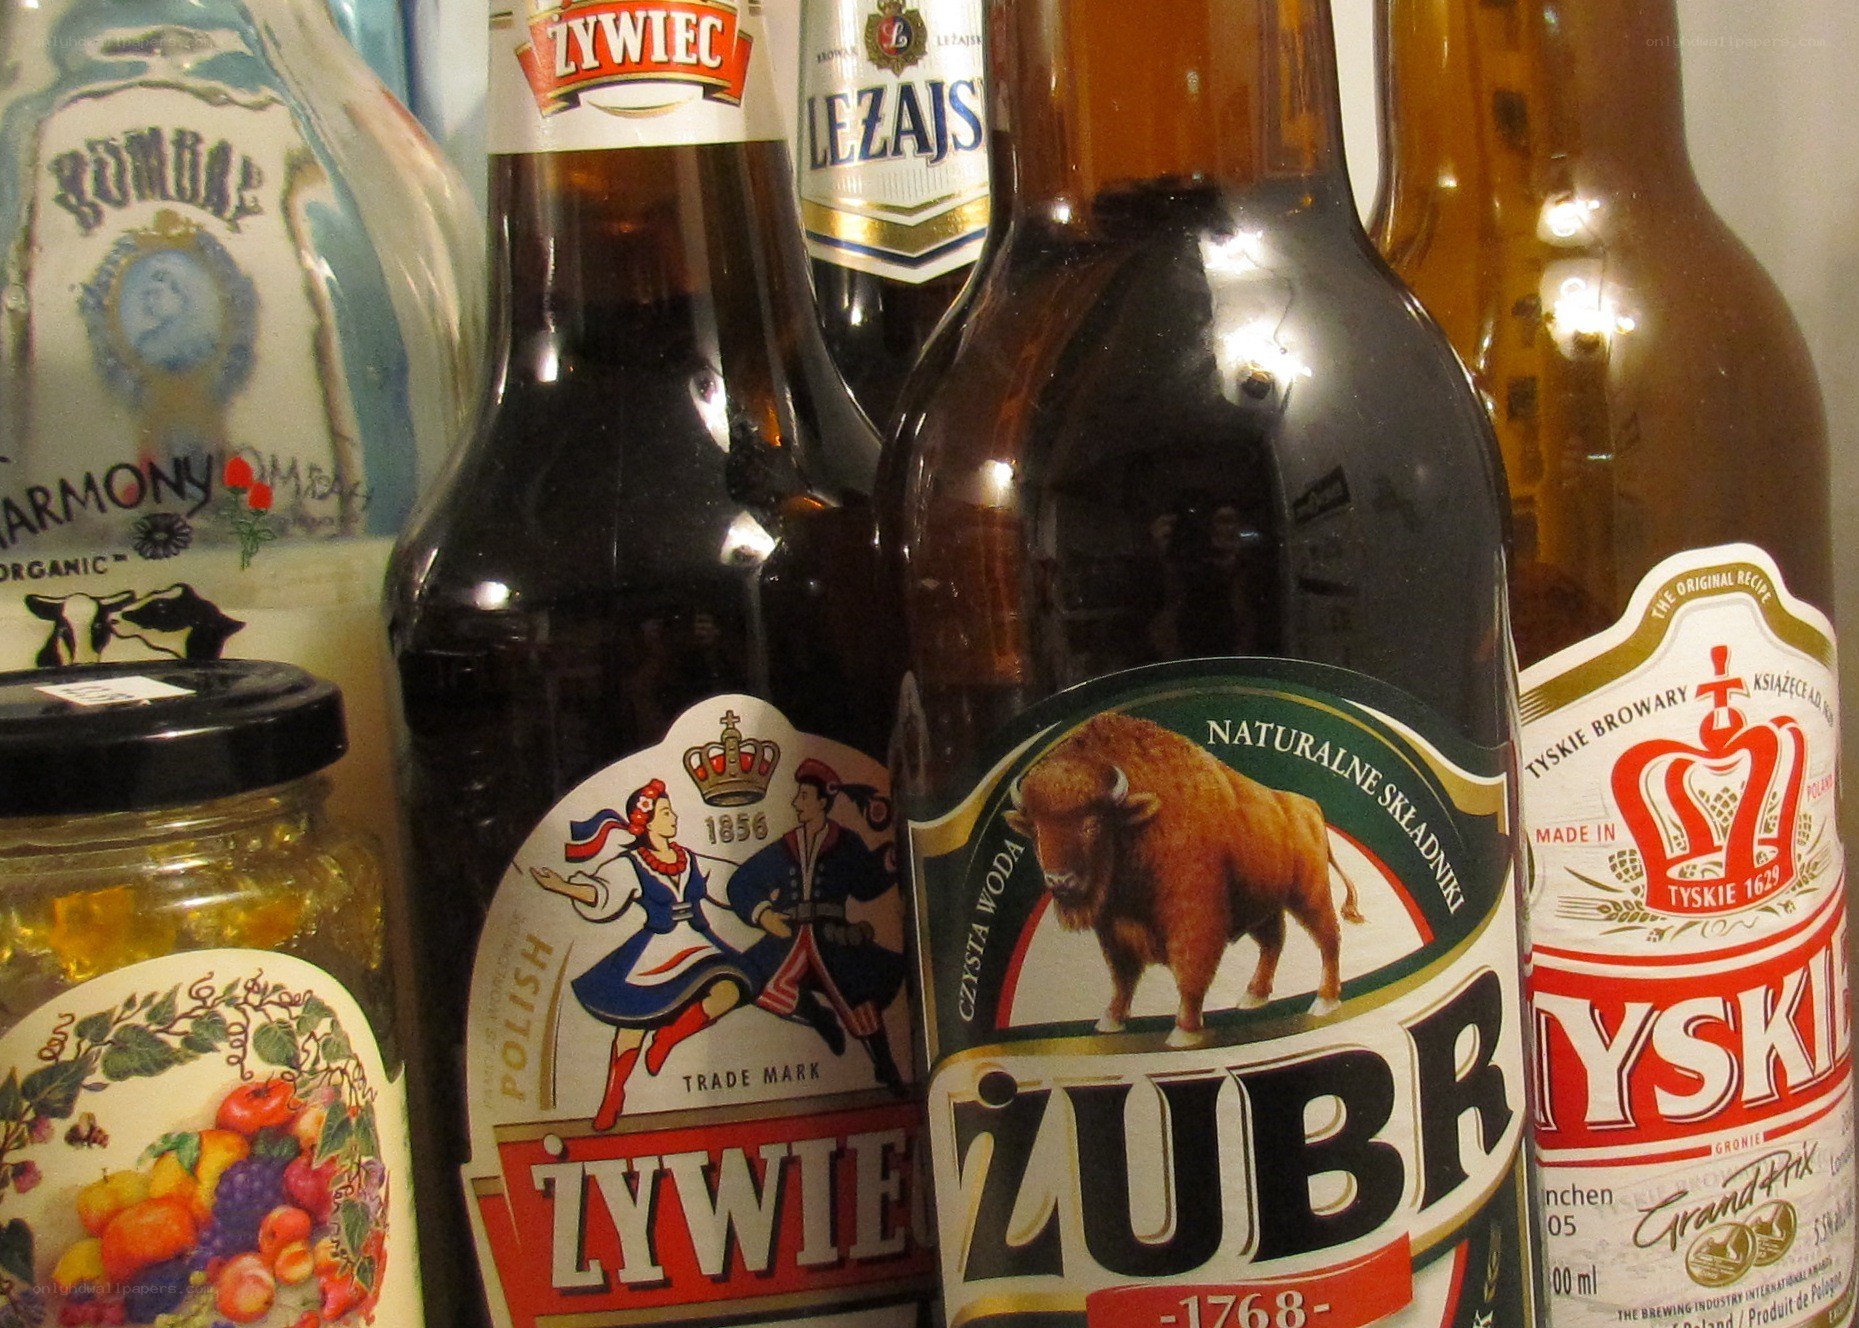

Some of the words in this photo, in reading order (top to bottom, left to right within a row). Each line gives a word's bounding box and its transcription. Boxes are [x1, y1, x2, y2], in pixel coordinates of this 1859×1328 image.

[546, 10, 723, 77] ŻYWIEC
[0, 455, 214, 548] ARMONY
[1651, 590, 1676, 619] THE
[1676, 571, 1734, 596] ORIGINAL
[1737, 570, 1771, 604] RECIPE
[1525, 729, 1589, 779] TYSKIE
[1591, 684, 1688, 738] BROWARY
[705, 811, 769, 845] 1856
[1207, 720, 1383, 795] NATURALNE
[1377, 783, 1465, 914] SKŁADNIKI
[1536, 825, 1589, 843] MADE
[1597, 823, 1615, 841] IN
[1668, 883, 1736, 907] TYSKIE
[1745, 865, 1780, 898] 1629
[959, 923, 990, 1022] CZYSTA
[976, 838, 1026, 915] WODA
[500, 934, 553, 1101] POLISH
[1529, 907, 1851, 1131] YSKIE
[683, 1069, 751, 1093] TRADE
[763, 1062, 820, 1084] MARK
[954, 968, 1513, 1283] ŻUBR
[1715, 1134, 1761, 1155] GRONIE
[1548, 1215, 1576, 1236] 05
[1633, 1166, 1760, 1251] Grand
[1578, 1265, 1597, 1294] ml
[1617, 1309, 1638, 1321] THE
[1641, 1304, 1692, 1320] BREWING
[1695, 1292, 1744, 1312] INDUSTRY
[1749, 1296, 1795, 1328] Produit
[1797, 1290, 1809, 1309] de
